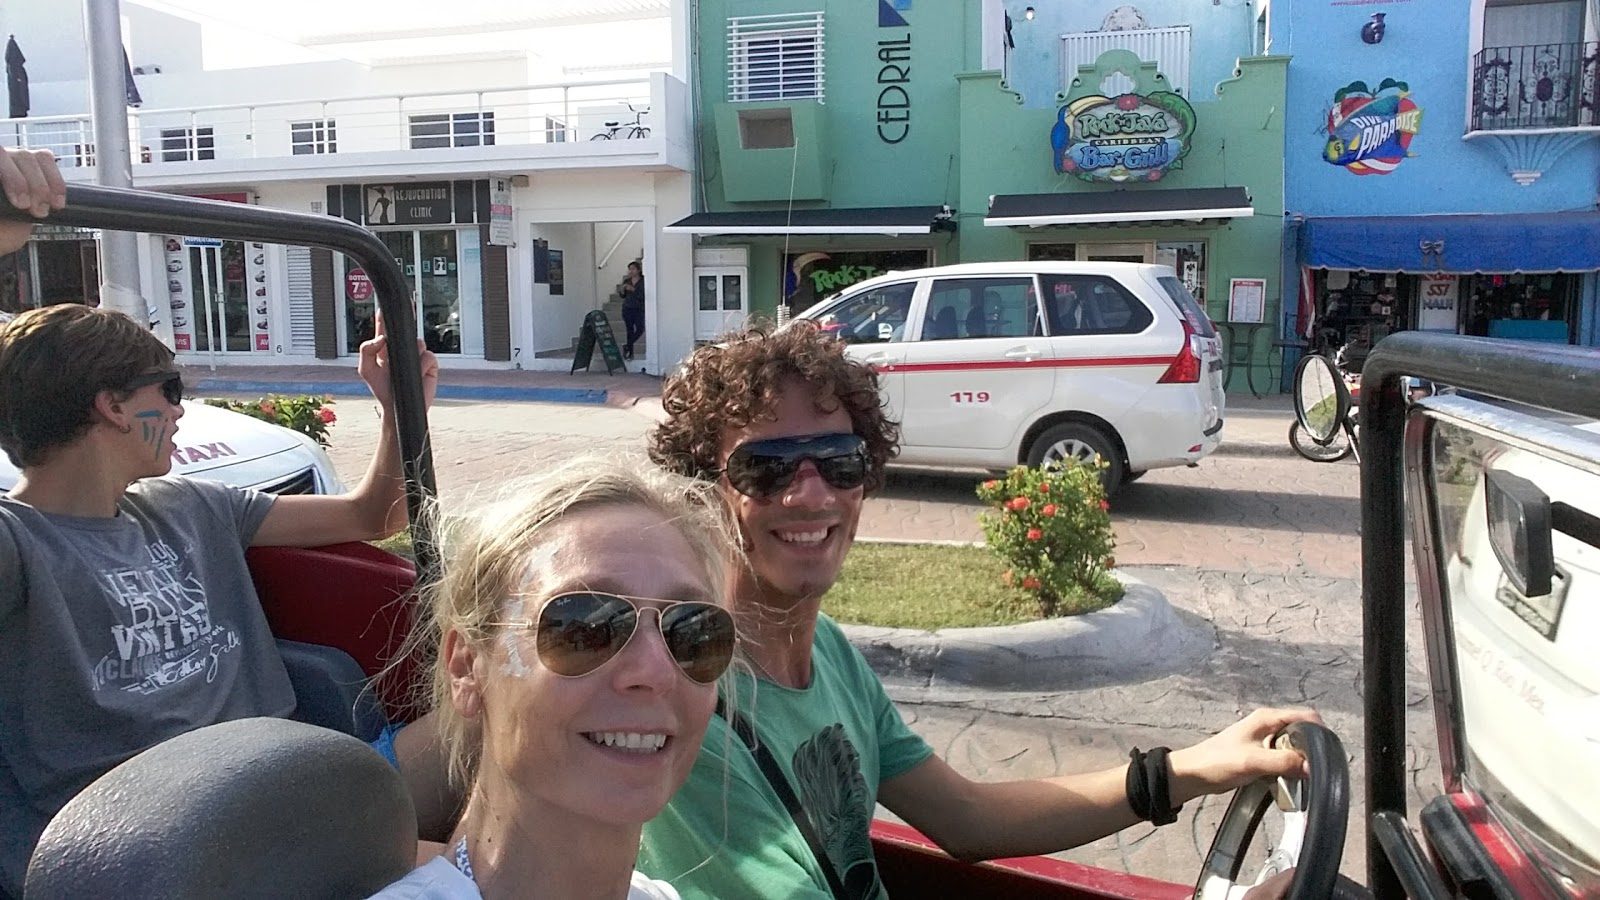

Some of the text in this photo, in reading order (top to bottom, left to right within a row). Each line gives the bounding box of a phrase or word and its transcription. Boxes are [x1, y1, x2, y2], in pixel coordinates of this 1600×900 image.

[877, 33, 911, 144] CEDRAL
[1350, 115, 1382, 129] DIVE
[1094, 137, 1162, 146] CARIBBEAN
[1355, 110, 1421, 160] PARADISE
[1080, 146, 1119, 169] Bar
[1124, 142, 1169, 170] Grill
[395, 187, 447, 201] REJUVENATION
[410, 206, 433, 218] CLINIC
[352, 282, 360, 293] 7
[276, 345, 283, 353] 6
[514, 347, 521, 357] 7
[950, 391, 990, 403] 119
[171, 442, 237, 465] TAXI
